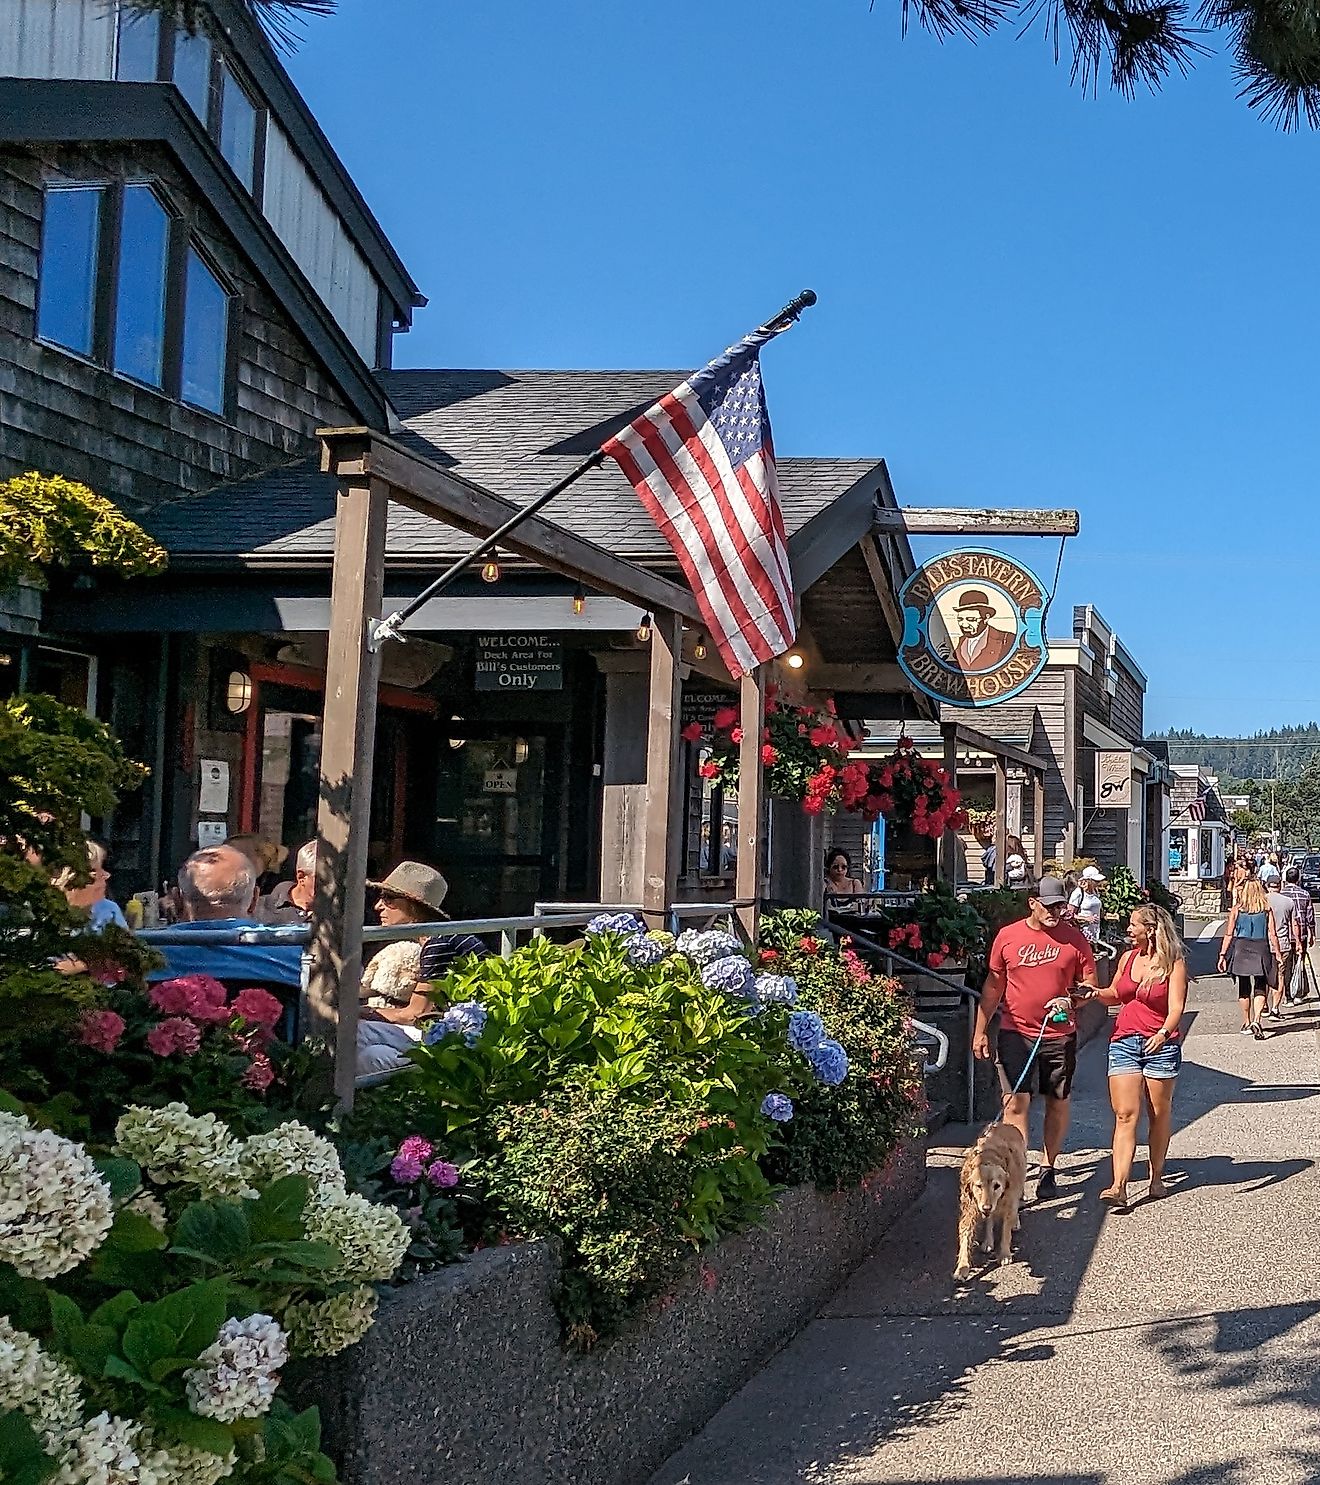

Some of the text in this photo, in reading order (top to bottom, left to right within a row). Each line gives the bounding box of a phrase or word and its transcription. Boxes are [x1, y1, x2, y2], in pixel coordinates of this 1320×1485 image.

[911, 555, 1037, 602] BILL'S TAVERN
[483, 651, 508, 660] Deck
[511, 651, 534, 660] Area
[476, 661, 561, 672] Bill's Customers
[498, 673, 538, 689] Only
[485, 780, 513, 789] OPEN
[1017, 943, 1061, 967] Lucky
